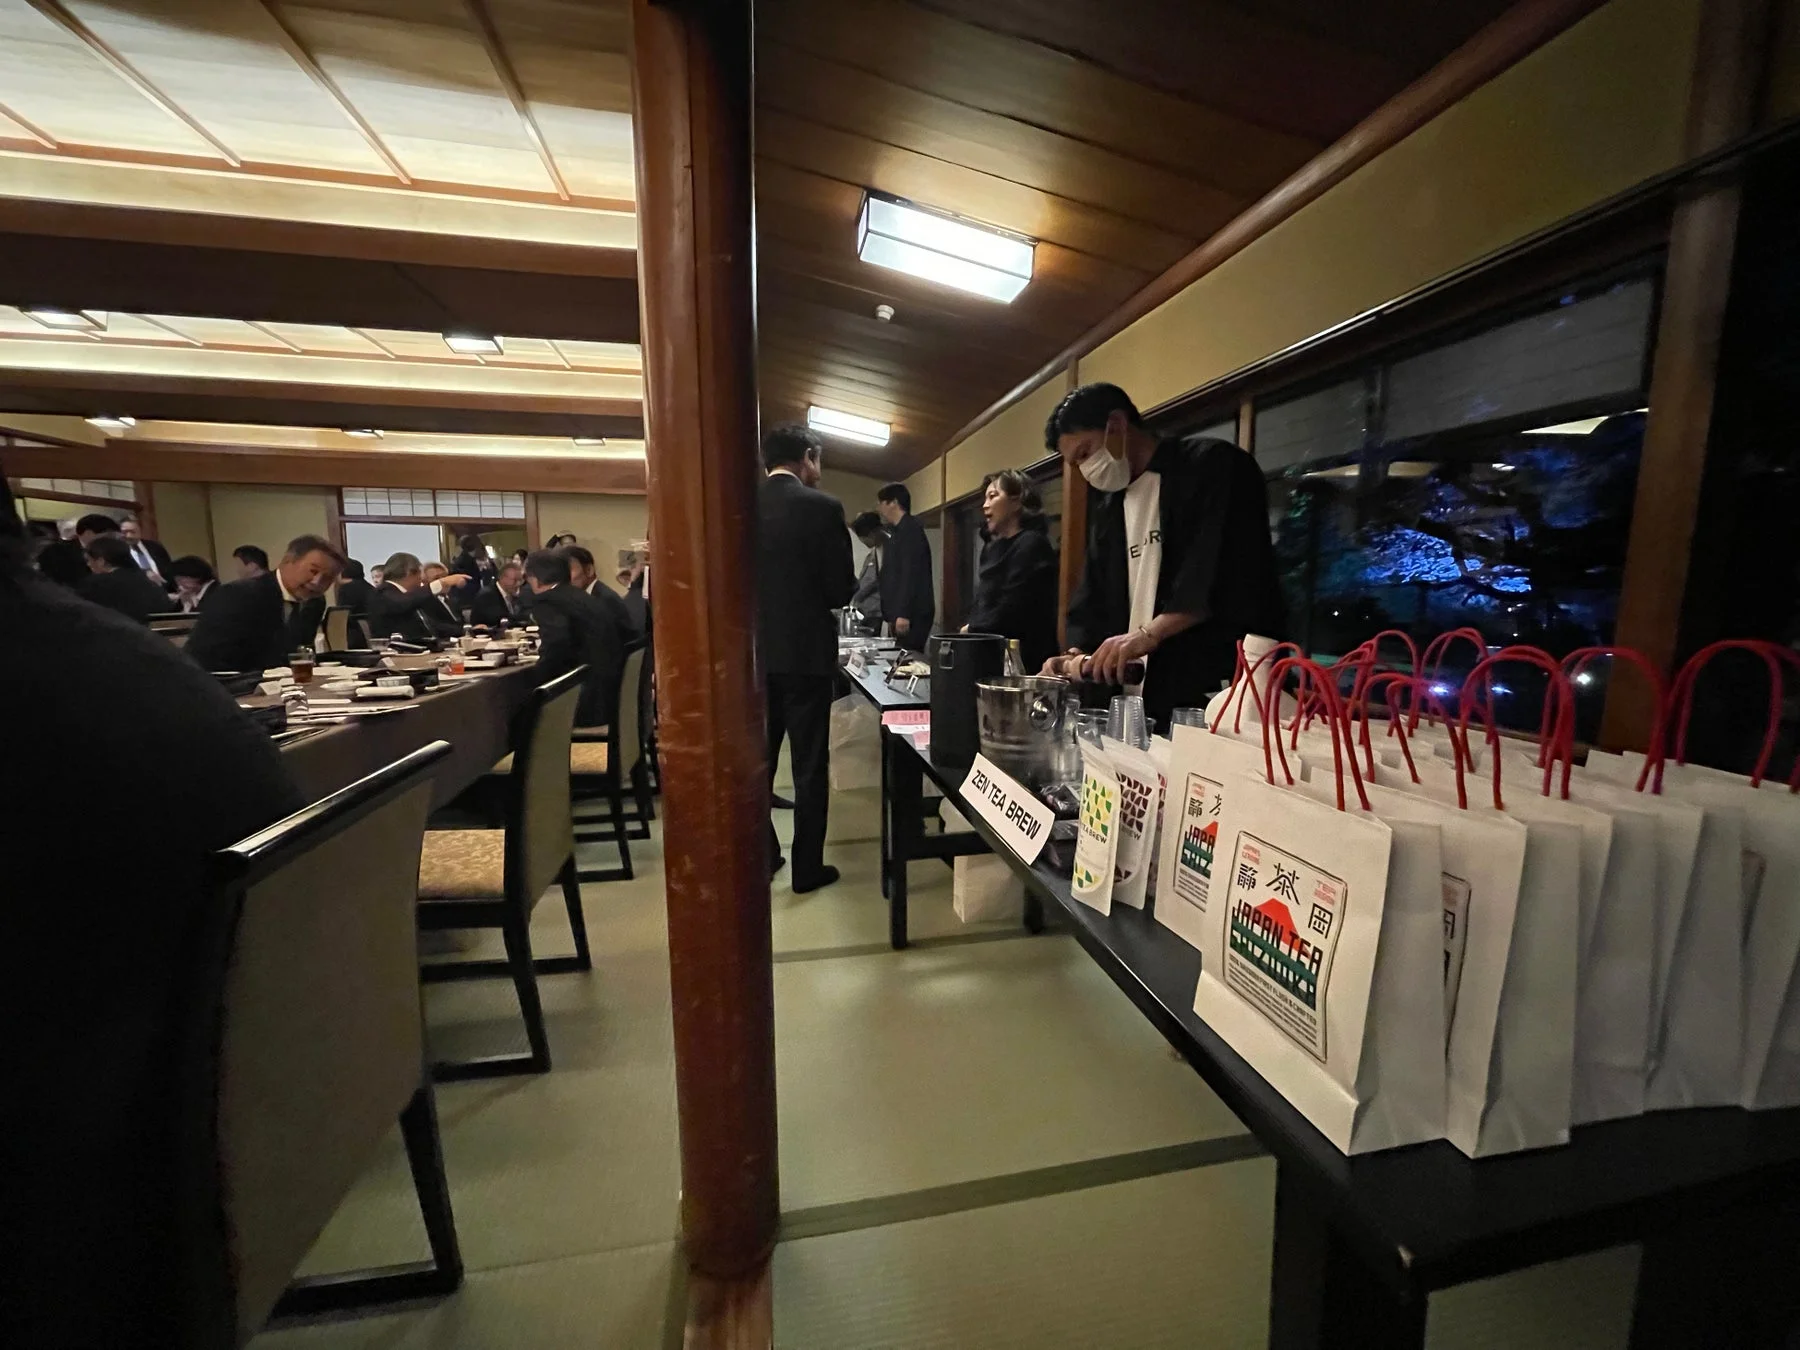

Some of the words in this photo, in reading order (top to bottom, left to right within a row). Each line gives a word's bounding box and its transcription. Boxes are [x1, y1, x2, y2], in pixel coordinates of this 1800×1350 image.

[971, 769, 991, 794] ZEN
[987, 782, 1007, 811] TEA
[1005, 799, 1042, 840] BREW
[1089, 828, 1108, 845] BREW
[1185, 824, 1216, 855] JAPA
[1264, 862, 1301, 906] 茶
[1231, 898, 1284, 949] JAPAN
[1288, 929, 1324, 977] TEA
[1307, 902, 1334, 940] 岡
